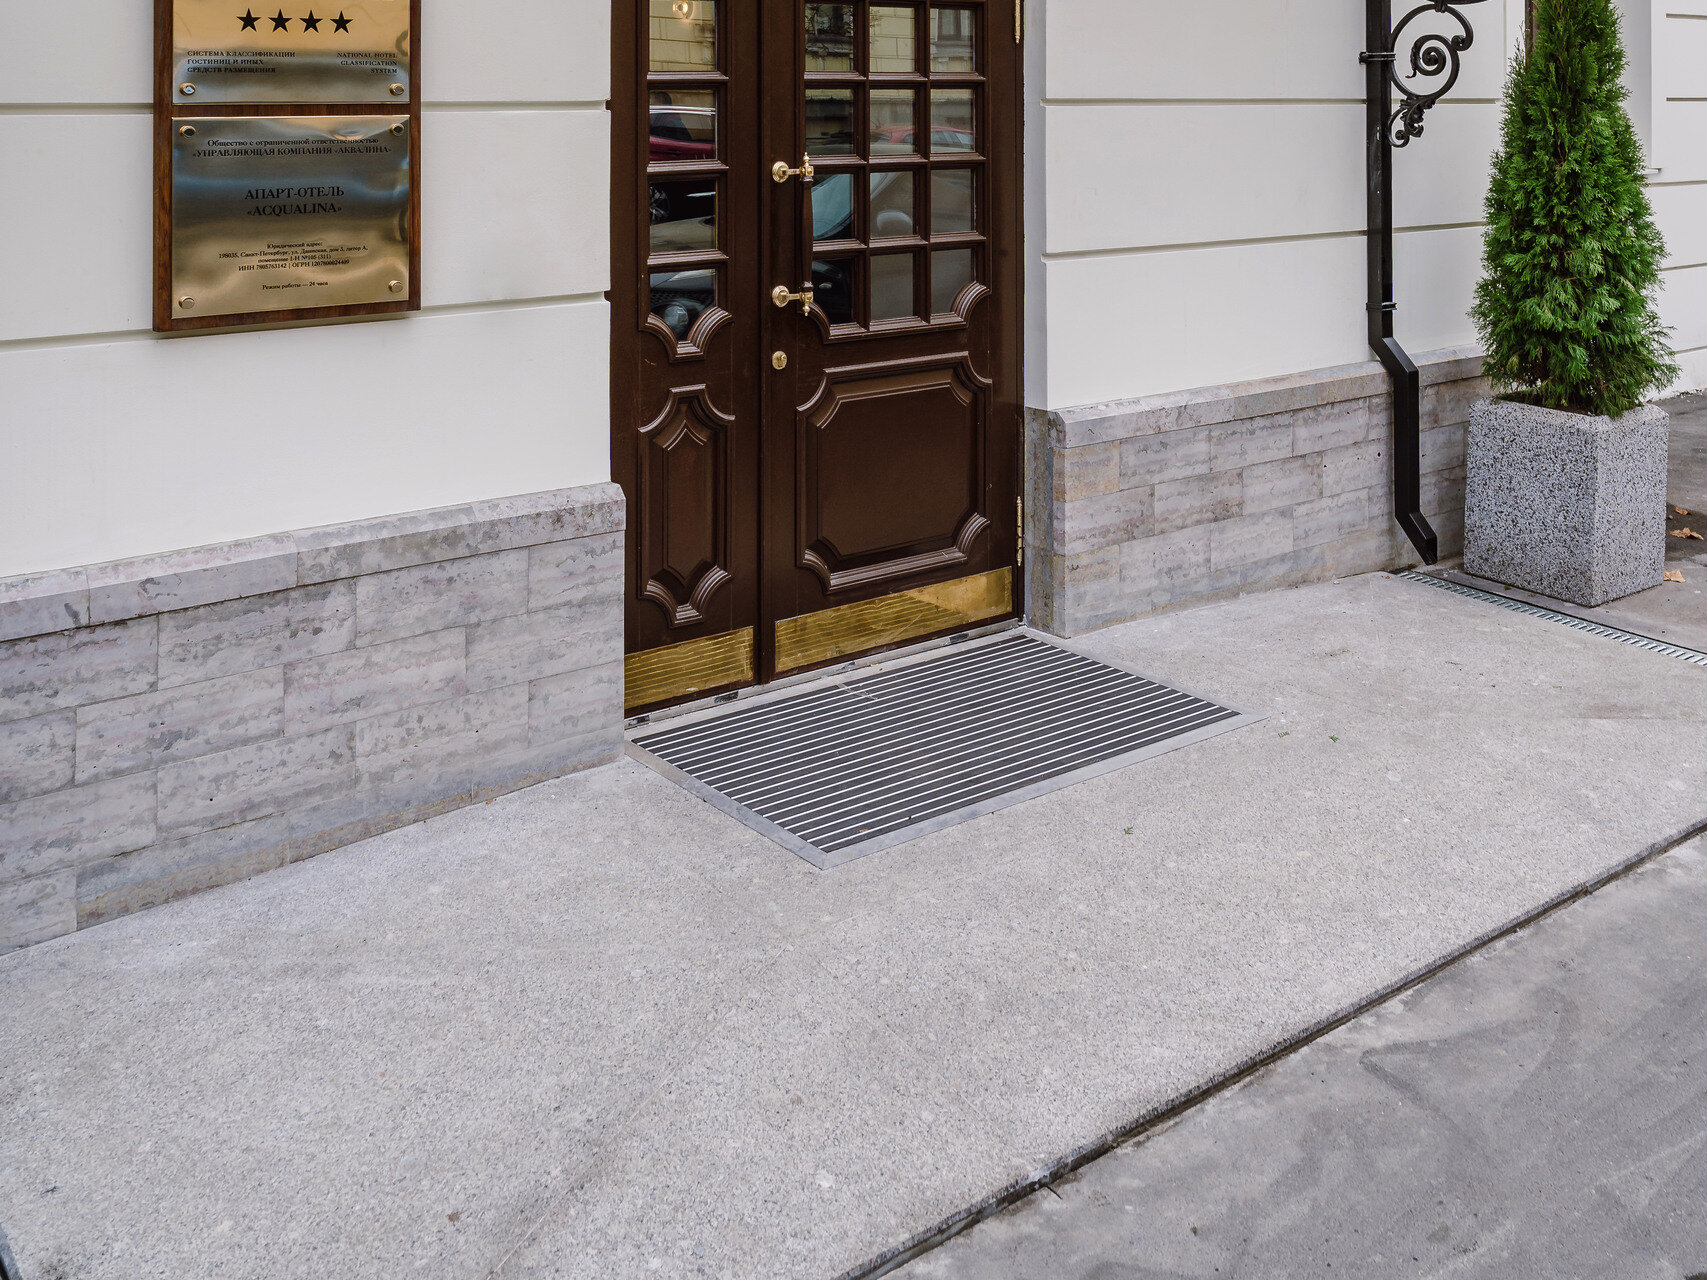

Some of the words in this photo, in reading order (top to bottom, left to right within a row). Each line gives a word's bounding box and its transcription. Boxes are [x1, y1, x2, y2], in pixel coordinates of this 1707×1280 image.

[207, 139, 247, 147] Общество
[255, 138, 309, 147] ограниченной
[193, 148, 275, 157] «УПРАВЛЯЮЩАЯ
[277, 147, 332, 155] КОМПАНИЯ
[335, 146, 392, 154] «АКВАЛИНА»
[244, 186, 345, 200] АПАРТ-ОТЕЛЬ
[247, 203, 342, 217] «ACQUALINA»
